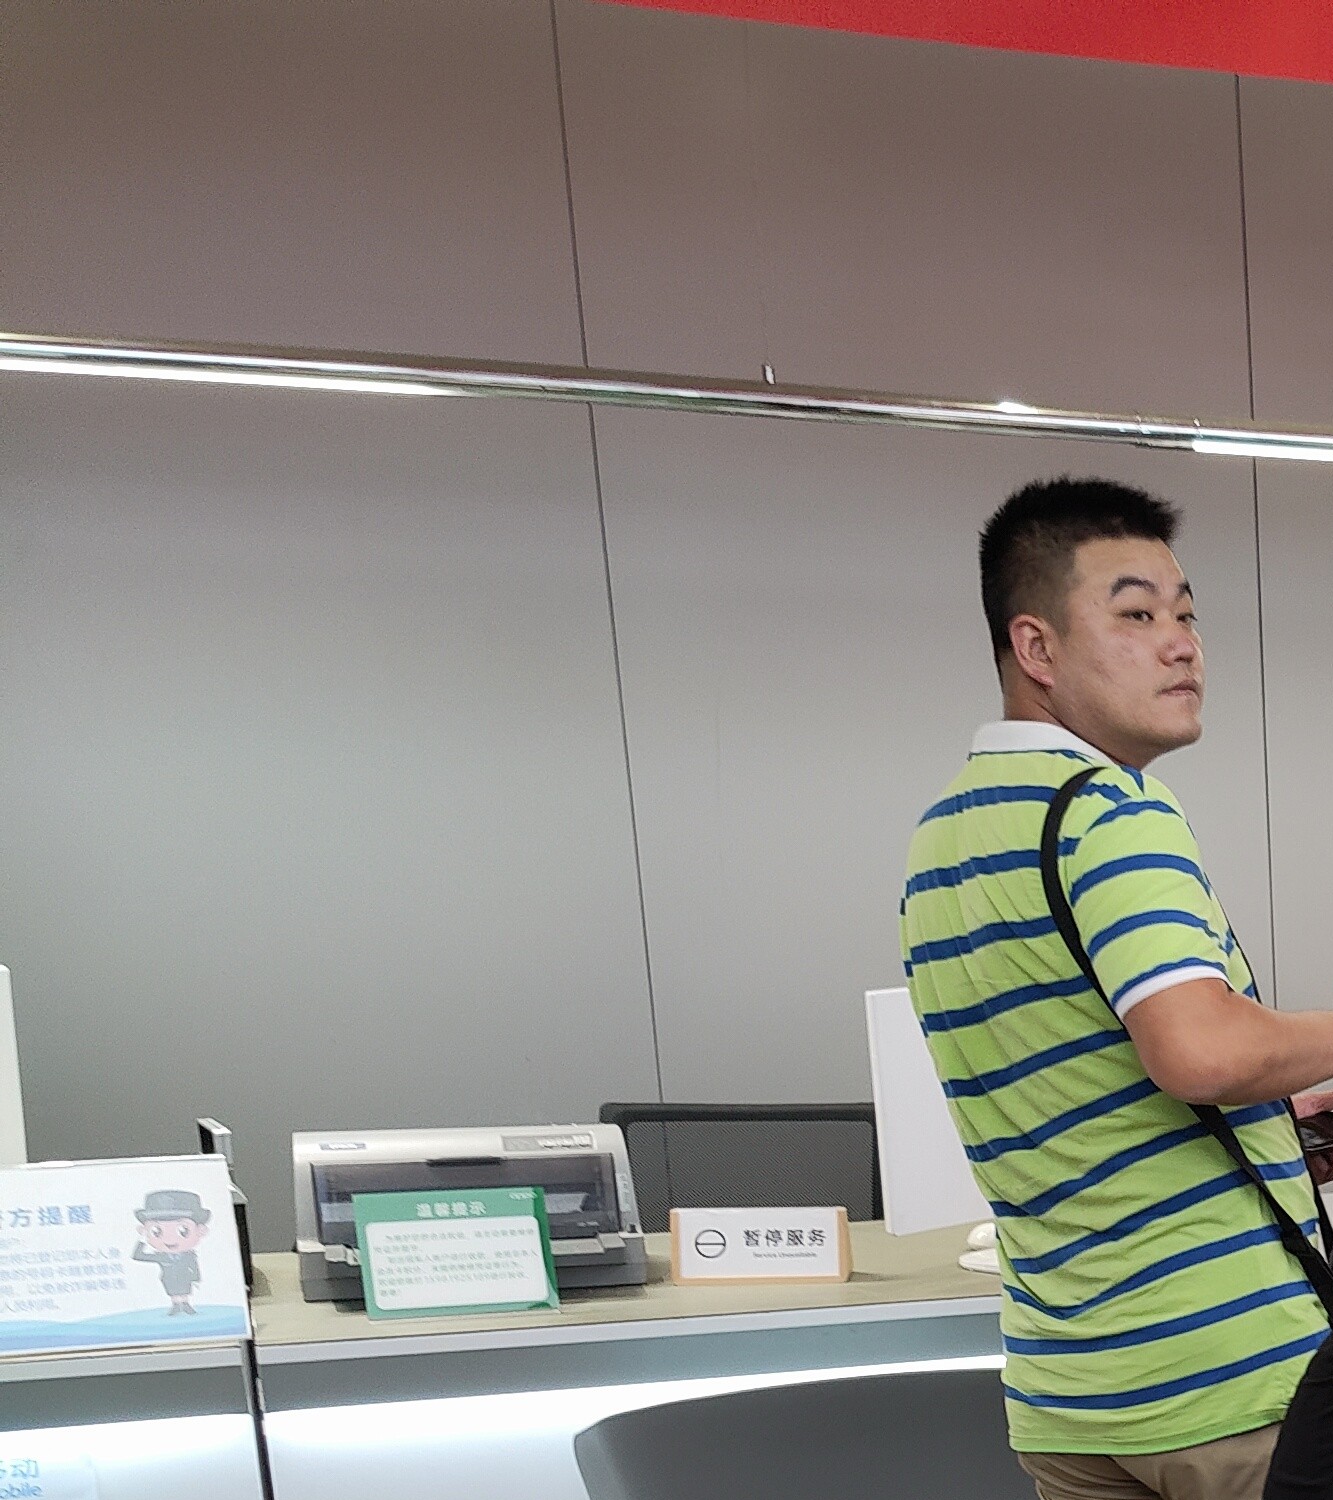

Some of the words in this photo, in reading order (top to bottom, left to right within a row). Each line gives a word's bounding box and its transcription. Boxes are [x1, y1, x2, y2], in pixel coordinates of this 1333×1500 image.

[0, 1205, 95, 1230] 方提醒
[743, 1228, 827, 1248] 暂停服务
